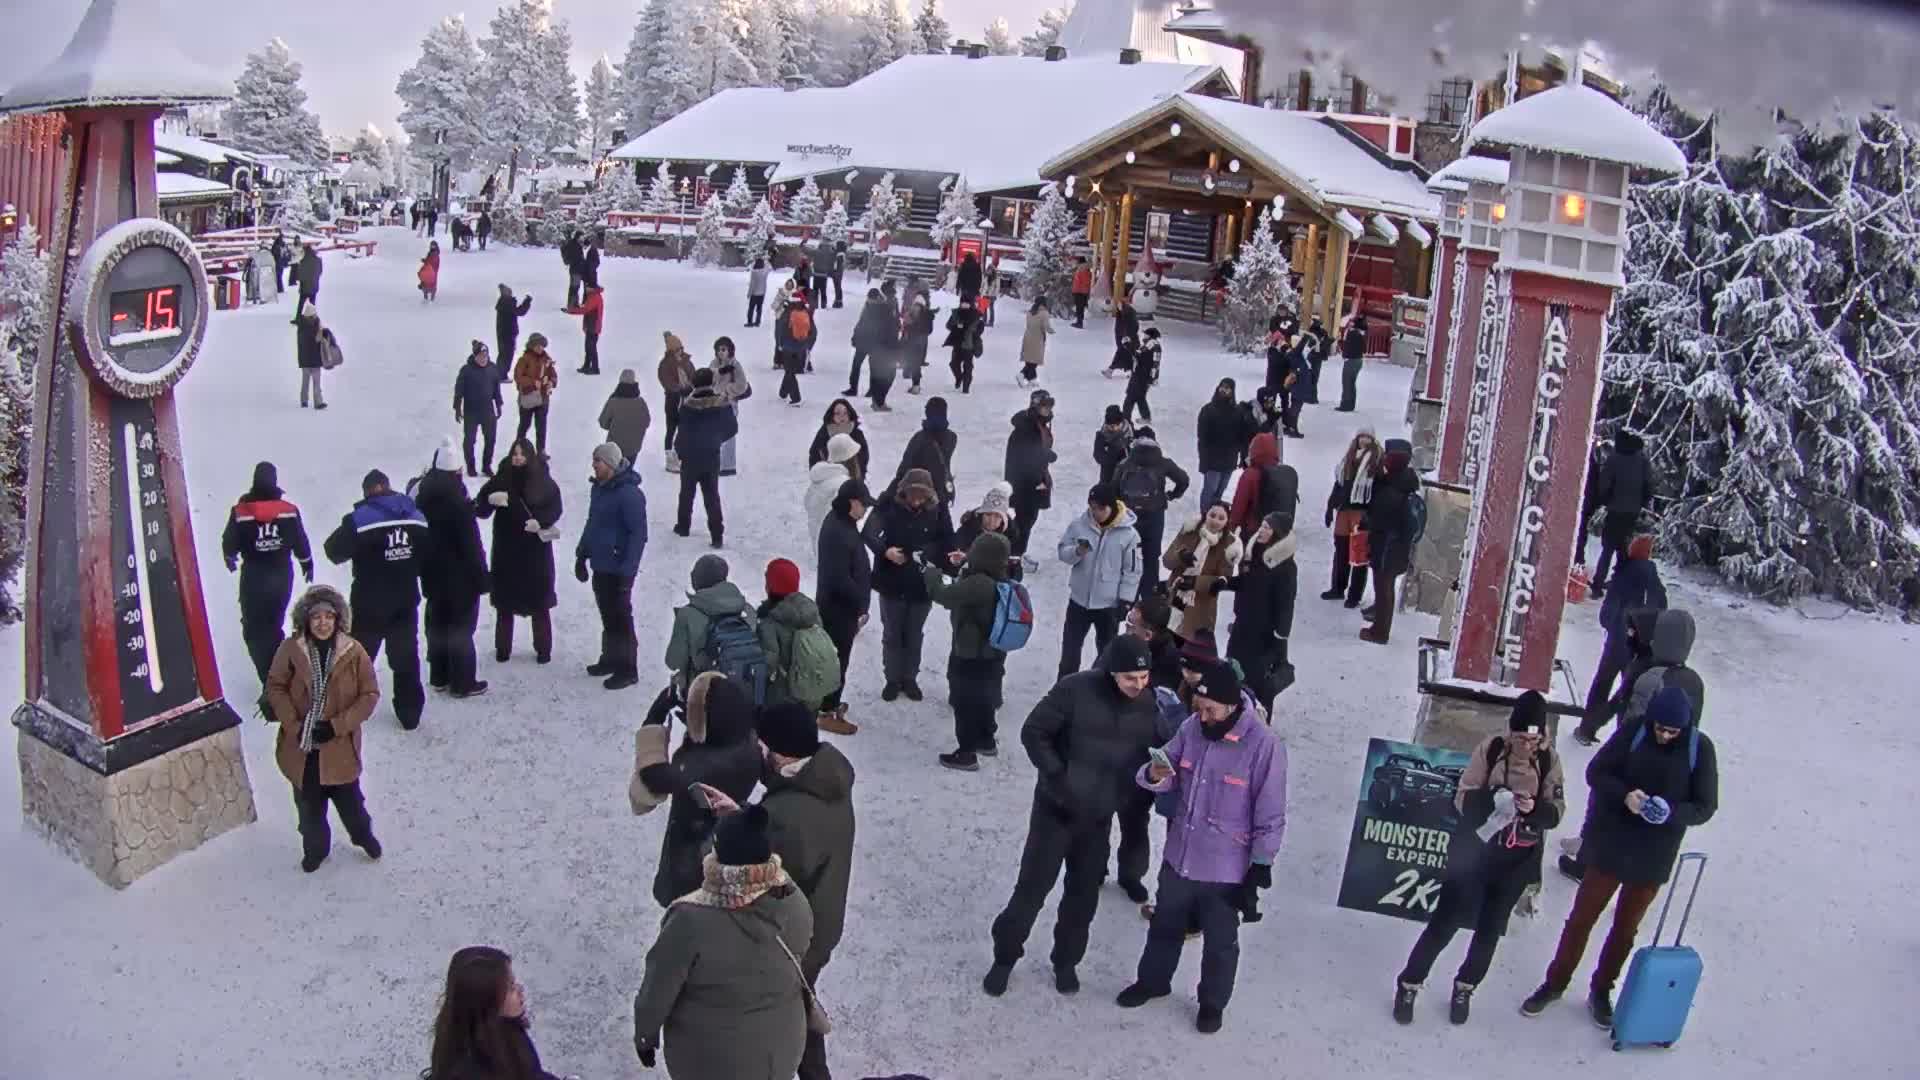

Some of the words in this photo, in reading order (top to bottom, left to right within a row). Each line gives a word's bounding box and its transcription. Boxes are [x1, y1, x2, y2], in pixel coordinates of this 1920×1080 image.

[152, 231, 194, 265] CIRCLE
[1476, 274, 1497, 368] ARCTIC
[1528, 316, 1568, 482] ARCTIC
[1465, 381, 1488, 479] CIRCLE
[141, 463, 155, 478] 30
[143, 491, 158, 506] 20
[147, 520, 159, 536] 10
[127, 554, 135, 569] 0
[149, 548, 157, 562] 0
[122, 582, 138, 598] -10
[1503, 505, 1544, 670] CIRCLE
[123, 609, 141, 625] -20
[127, 635, 144, 651] -30
[130, 663, 149, 679] -40
[1363, 818, 1450, 854] MONSTER
[1386, 846, 1449, 869] EXPERI
[1377, 869, 1442, 912] 2K
